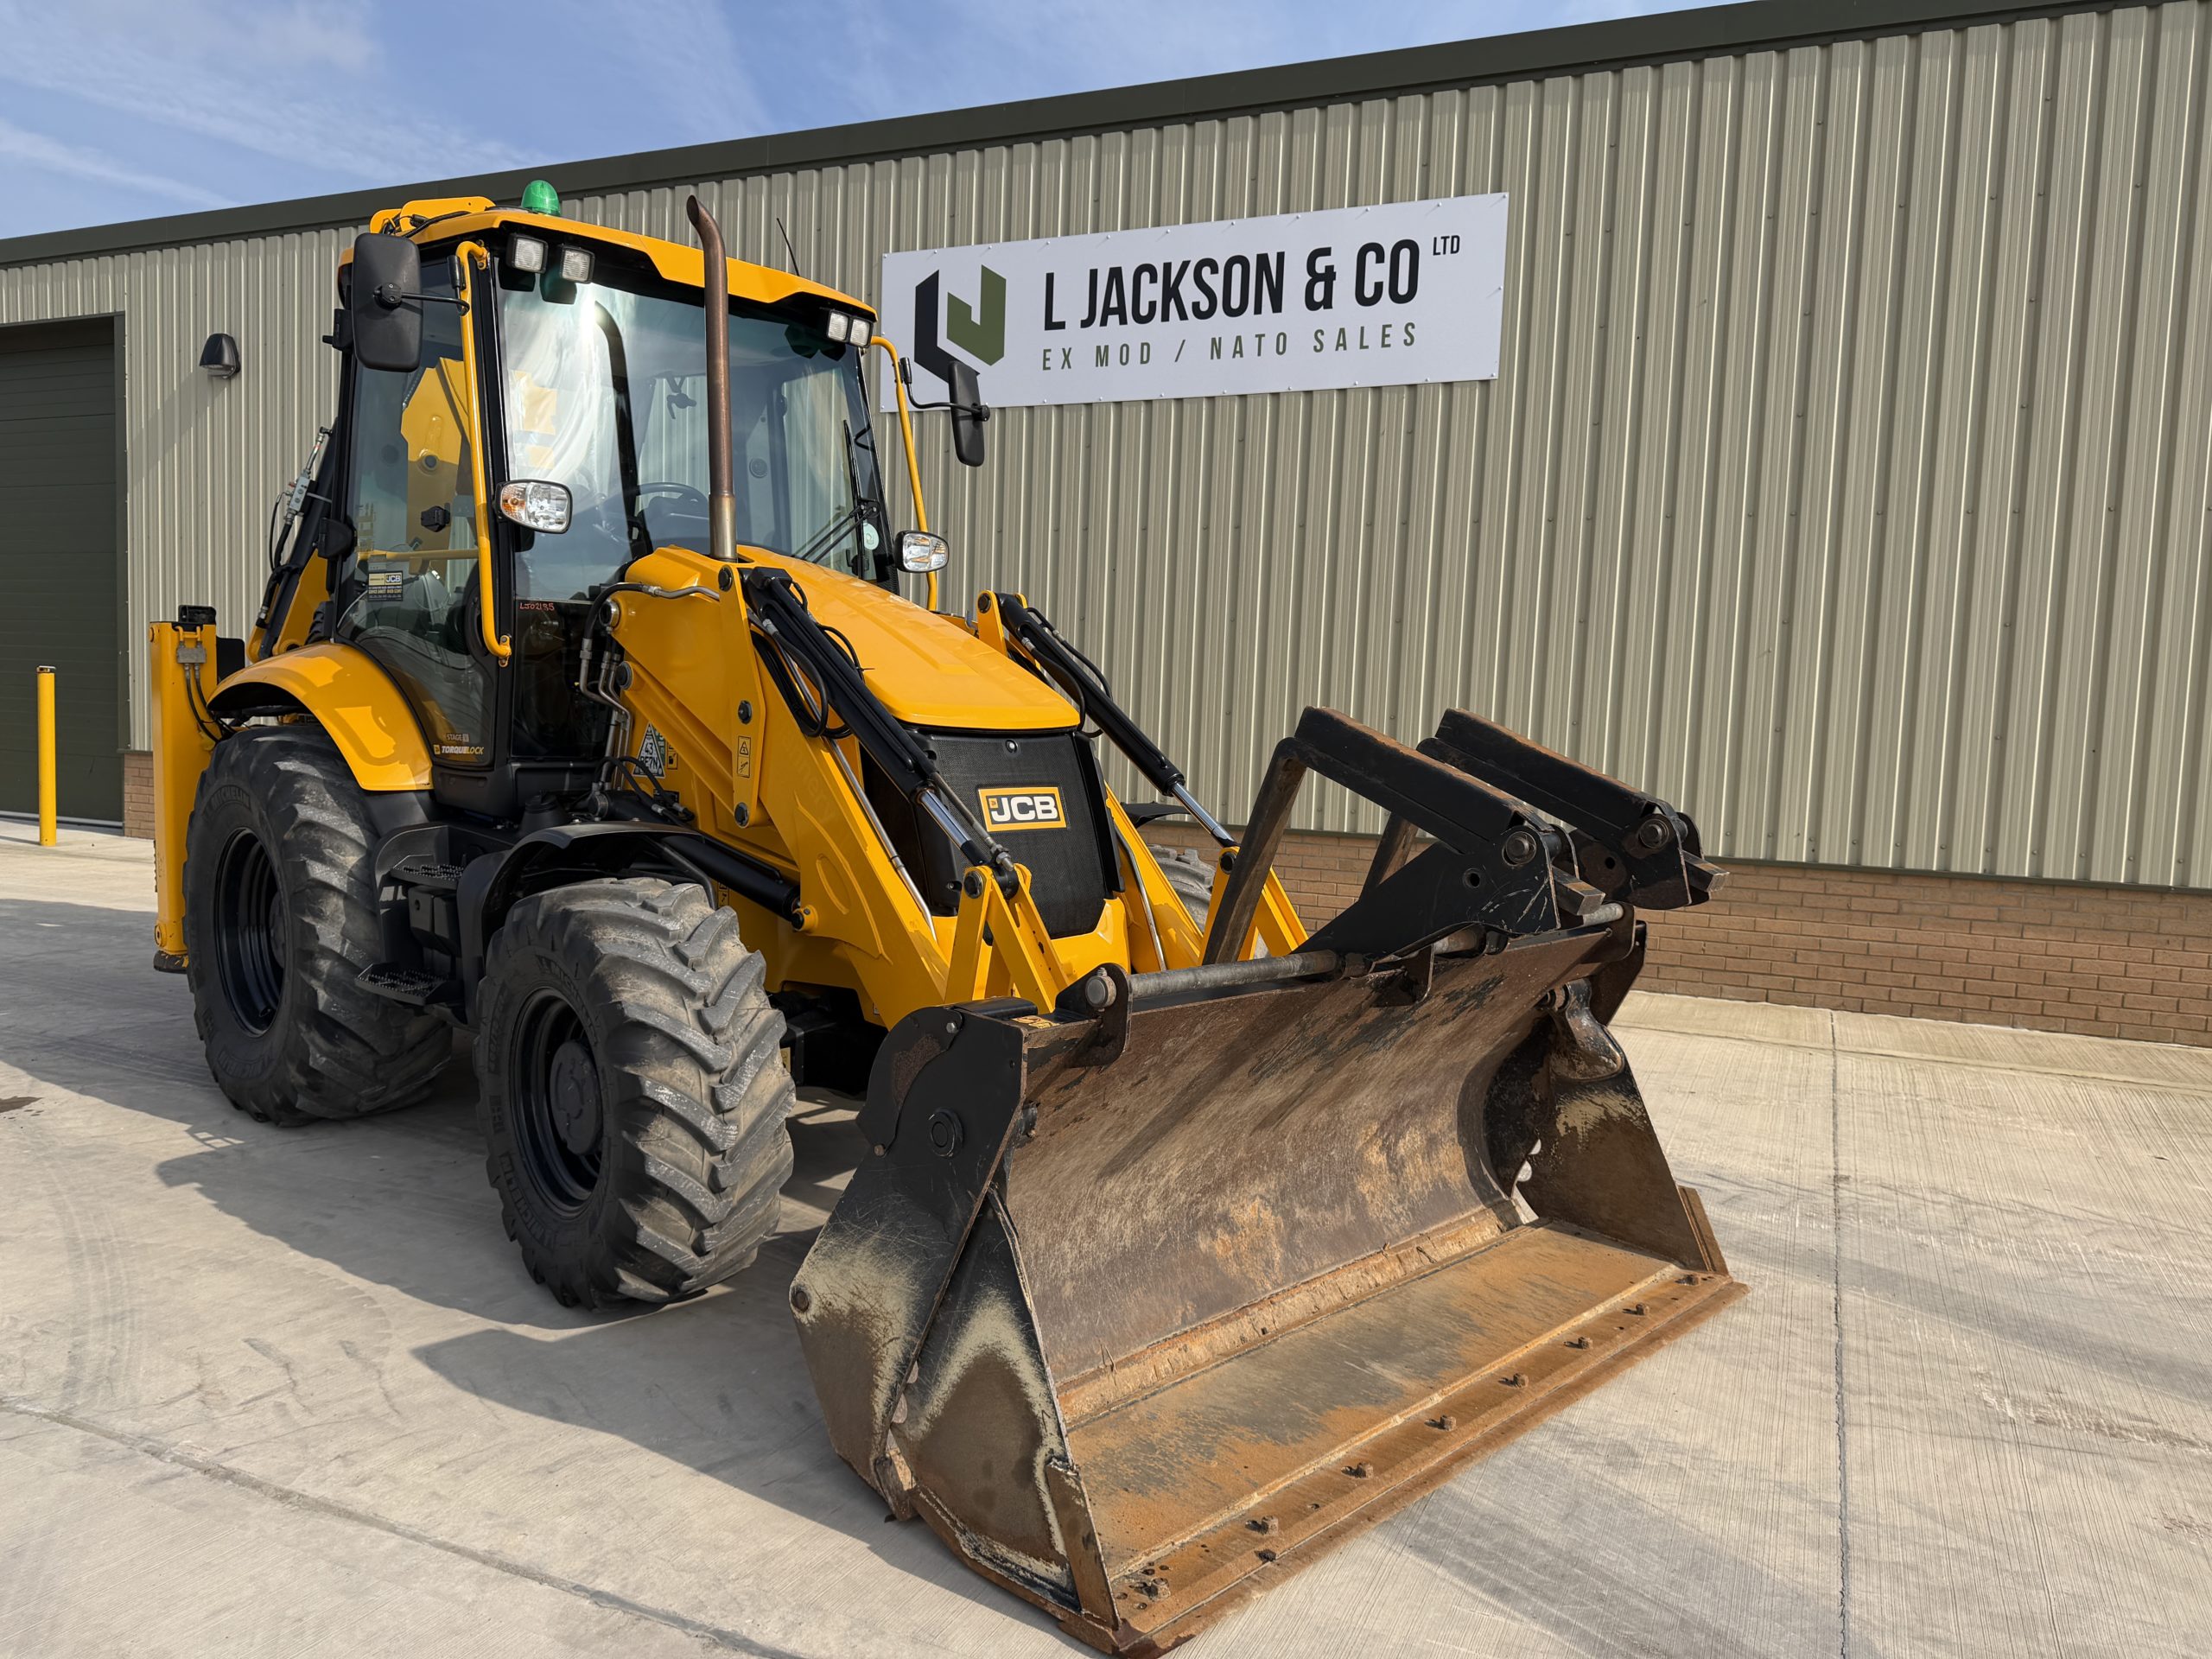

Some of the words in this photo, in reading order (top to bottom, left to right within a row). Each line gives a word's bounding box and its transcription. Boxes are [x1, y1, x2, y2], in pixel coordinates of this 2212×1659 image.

[1044, 271, 1066, 332] L
[1079, 251, 1286, 329] JACKSON
[1304, 247, 1338, 312] &
[1355, 239, 1421, 308] CO
[1433, 235, 1461, 257] LTD
[1042, 347, 1072, 372] EX
[1095, 342, 1151, 368] MOD
[1174, 340, 1186, 363] /
[1210, 332, 1287, 360] NATO
[1313, 322, 1415, 353] SALES
[385, 575, 401, 583] JCB
[442, 745, 484, 754] TORQUELOCK
[990, 796, 1058, 822] JCB
